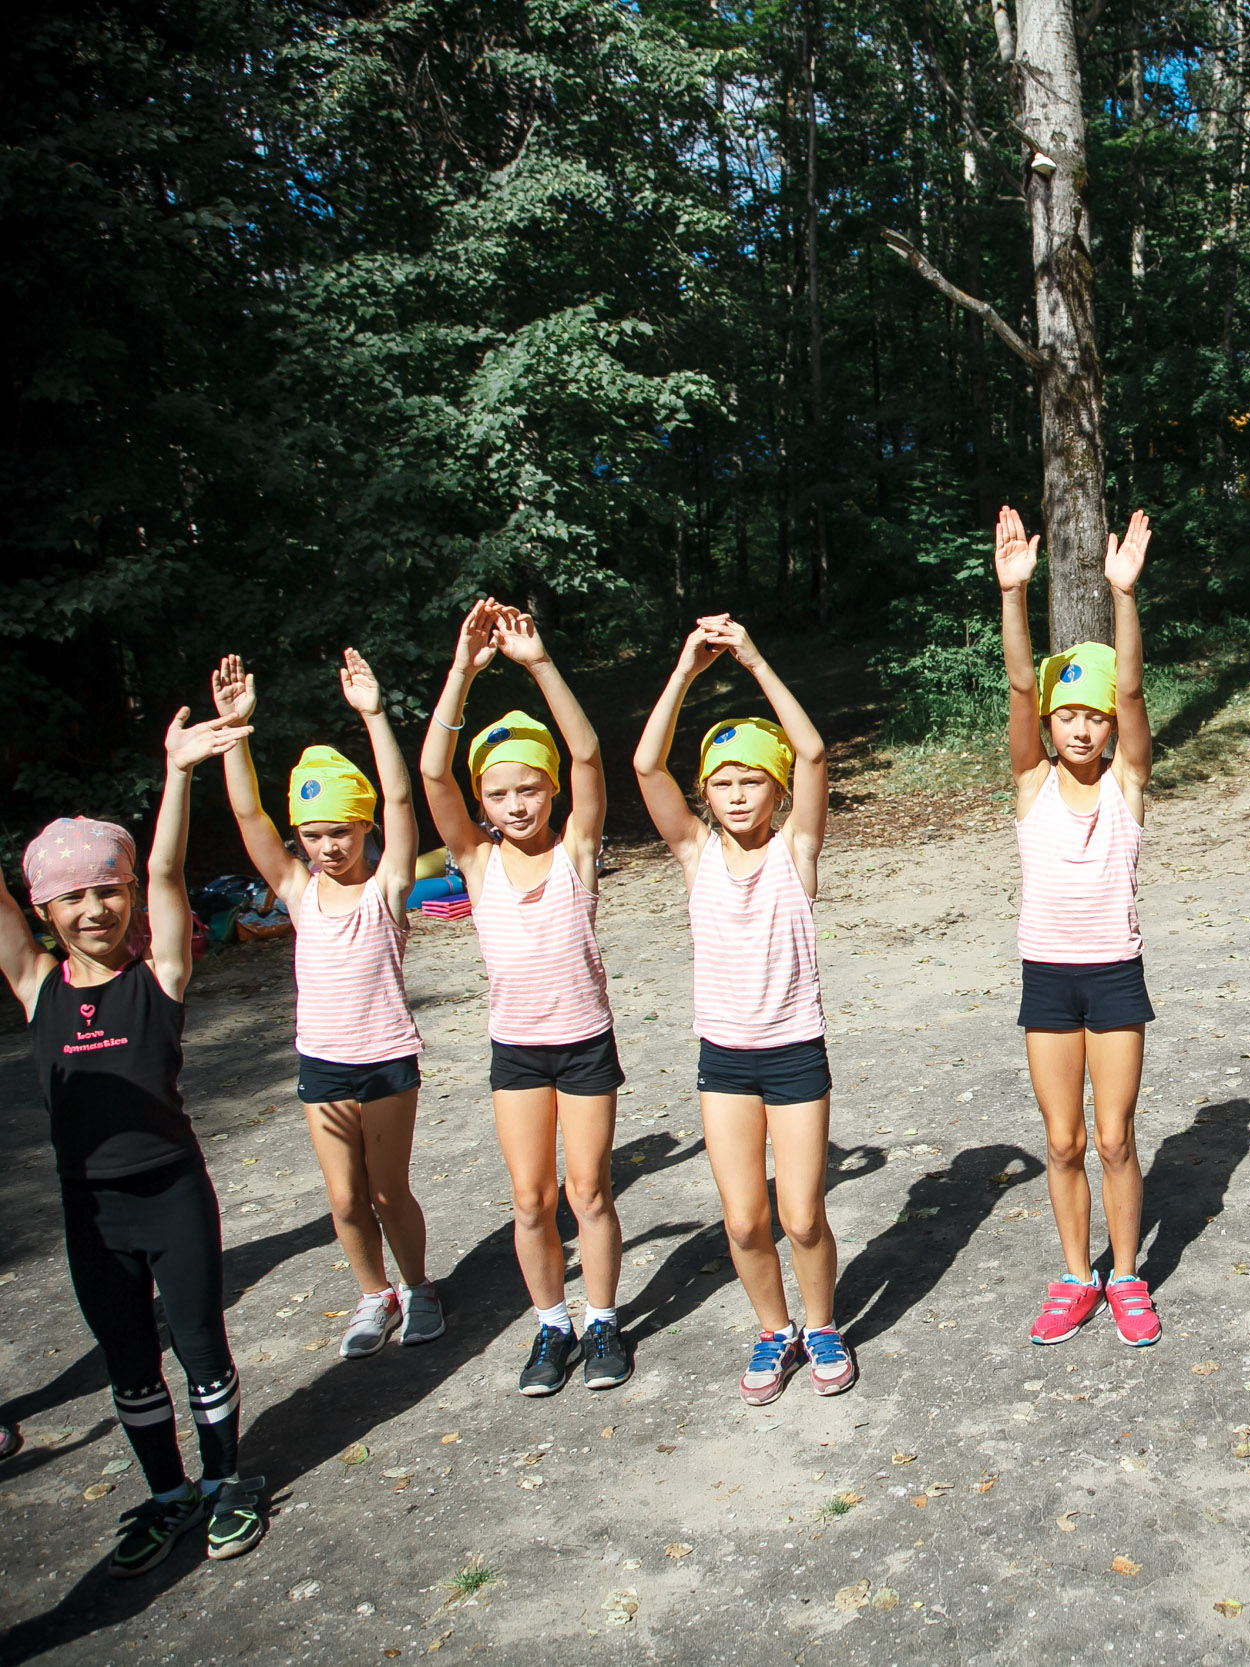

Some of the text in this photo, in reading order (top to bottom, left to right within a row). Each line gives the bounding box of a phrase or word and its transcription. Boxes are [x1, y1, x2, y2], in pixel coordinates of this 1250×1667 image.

[86, 1019, 92, 1027] I
[76, 1030, 104, 1040] Love
[63, 1037, 128, 1054] Gymnastics
